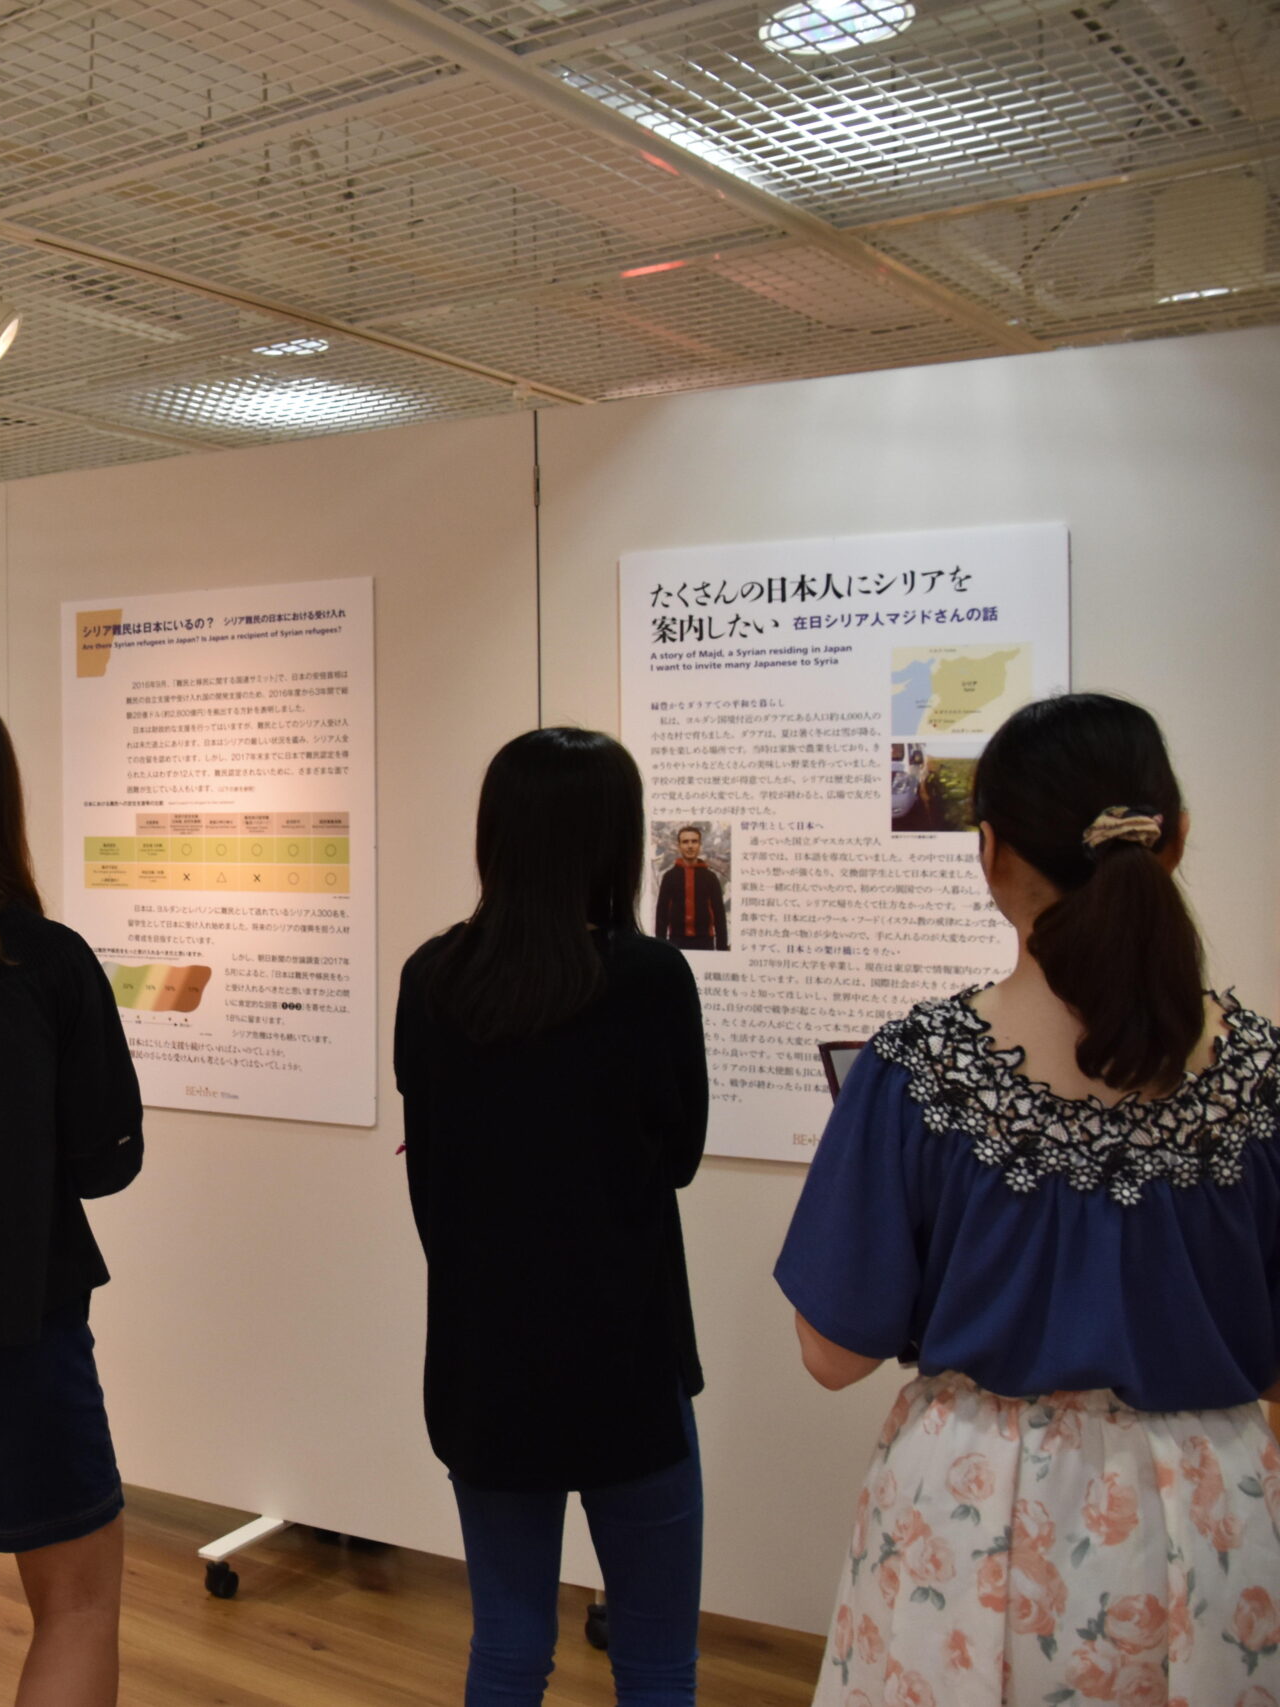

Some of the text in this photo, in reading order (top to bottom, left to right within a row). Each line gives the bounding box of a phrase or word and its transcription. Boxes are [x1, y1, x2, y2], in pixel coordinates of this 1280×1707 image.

[650, 565, 972, 608] たくさんの日本人にシリアを
[651, 606, 999, 643] 案内したい 在日シリア人マジドさんの話
[82, 642, 94, 650] Are
[95, 642, 112, 650] there
[113, 640, 135, 651] Syrian
[136, 638, 166, 650] refugees
[176, 635, 199, 645] Japan?
[208, 633, 229, 643] Japan
[237, 630, 268, 641] recipient
[270, 629, 278, 637] of
[280, 628, 303, 638] Syrian
[305, 625, 342, 637] refugees?
[650, 652, 658, 660] A
[660, 651, 683, 662] story
[686, 649, 696, 659] of
[698, 649, 724, 660] Majd,
[736, 648, 766, 659] Syrian
[769, 646, 808, 657] residing
[811, 645, 821, 653] in
[823, 645, 852, 655] Japan
[656, 663, 680, 672] want
[682, 662, 692, 671] to
[695, 661, 721, 670] invite
[725, 661, 751, 671] many
[753, 659, 798, 669] Japanese
[801, 658, 811, 666] to
[813, 657, 839, 667] Syria
